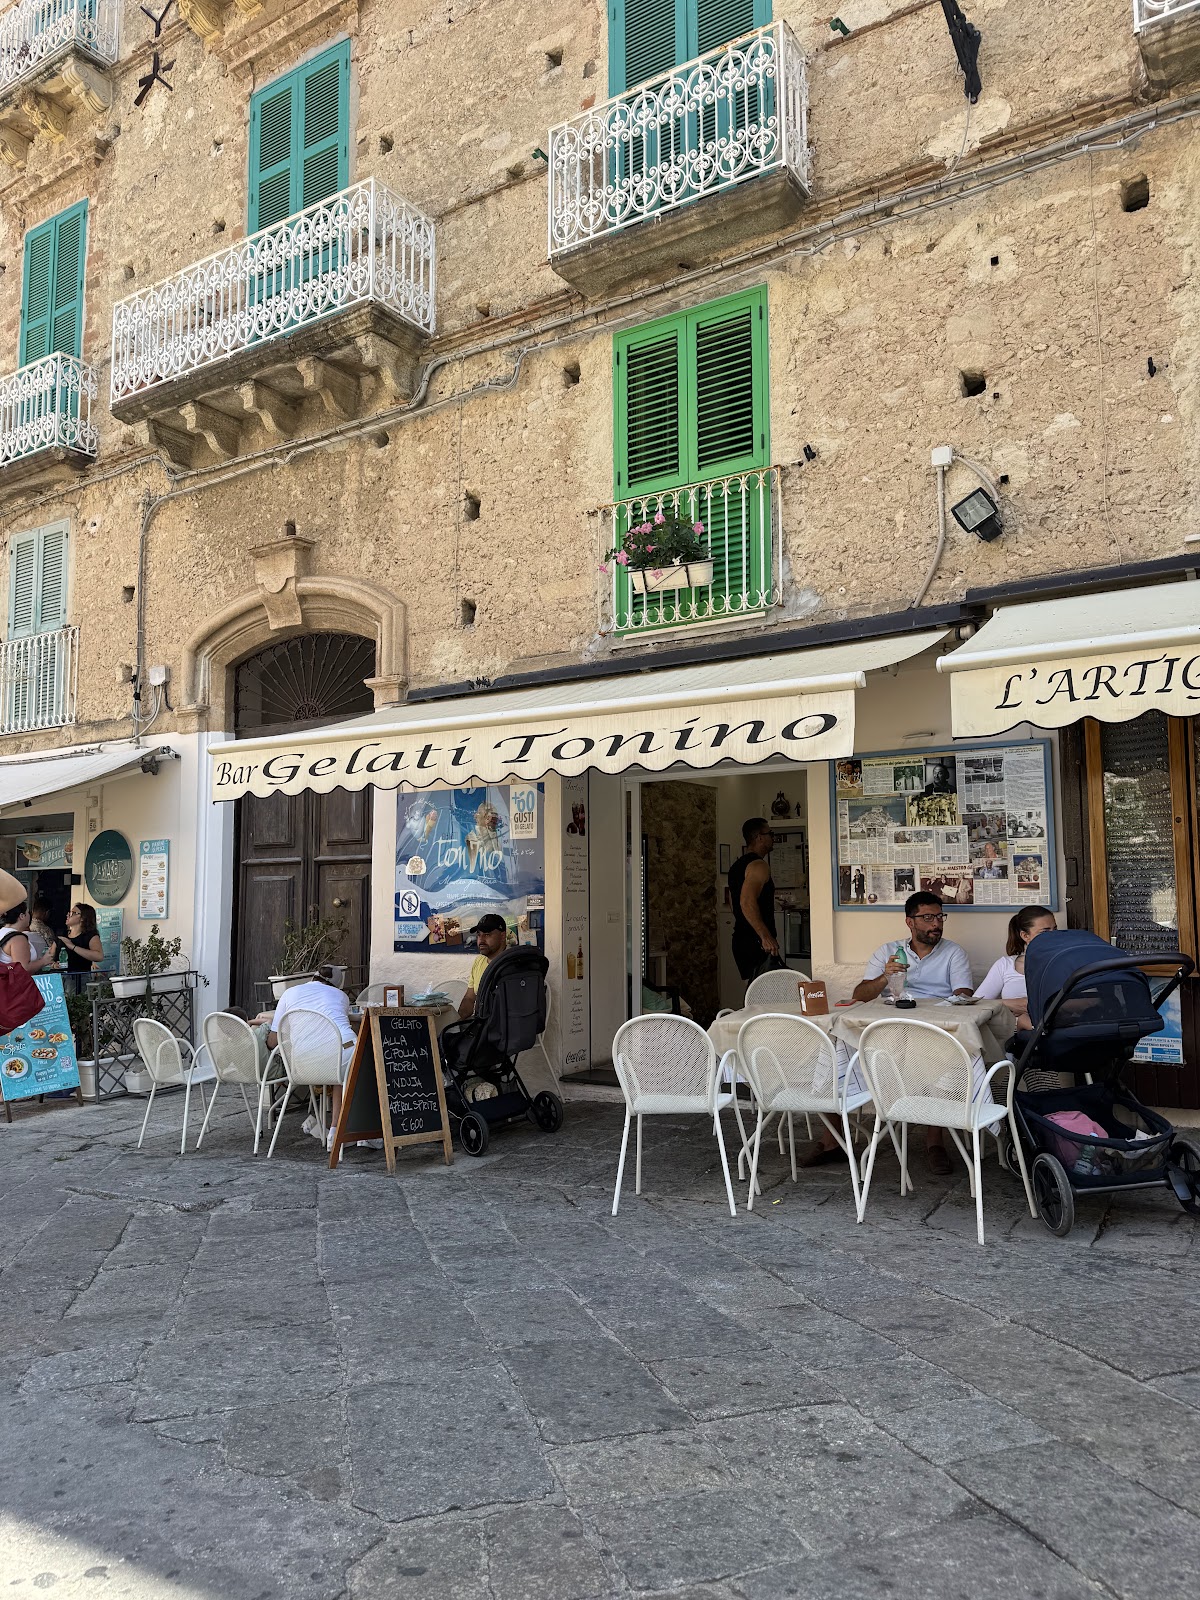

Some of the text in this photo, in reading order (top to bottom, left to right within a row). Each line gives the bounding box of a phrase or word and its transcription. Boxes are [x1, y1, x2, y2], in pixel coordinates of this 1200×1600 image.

[216, 713, 838, 787] Bar Gelati Tonino
[513, 811, 534, 823] GUSTI
[390, 1017, 423, 1030] GELATO
[382, 1034, 408, 1048] ALLA
[385, 1060, 418, 1072] TROPEA
